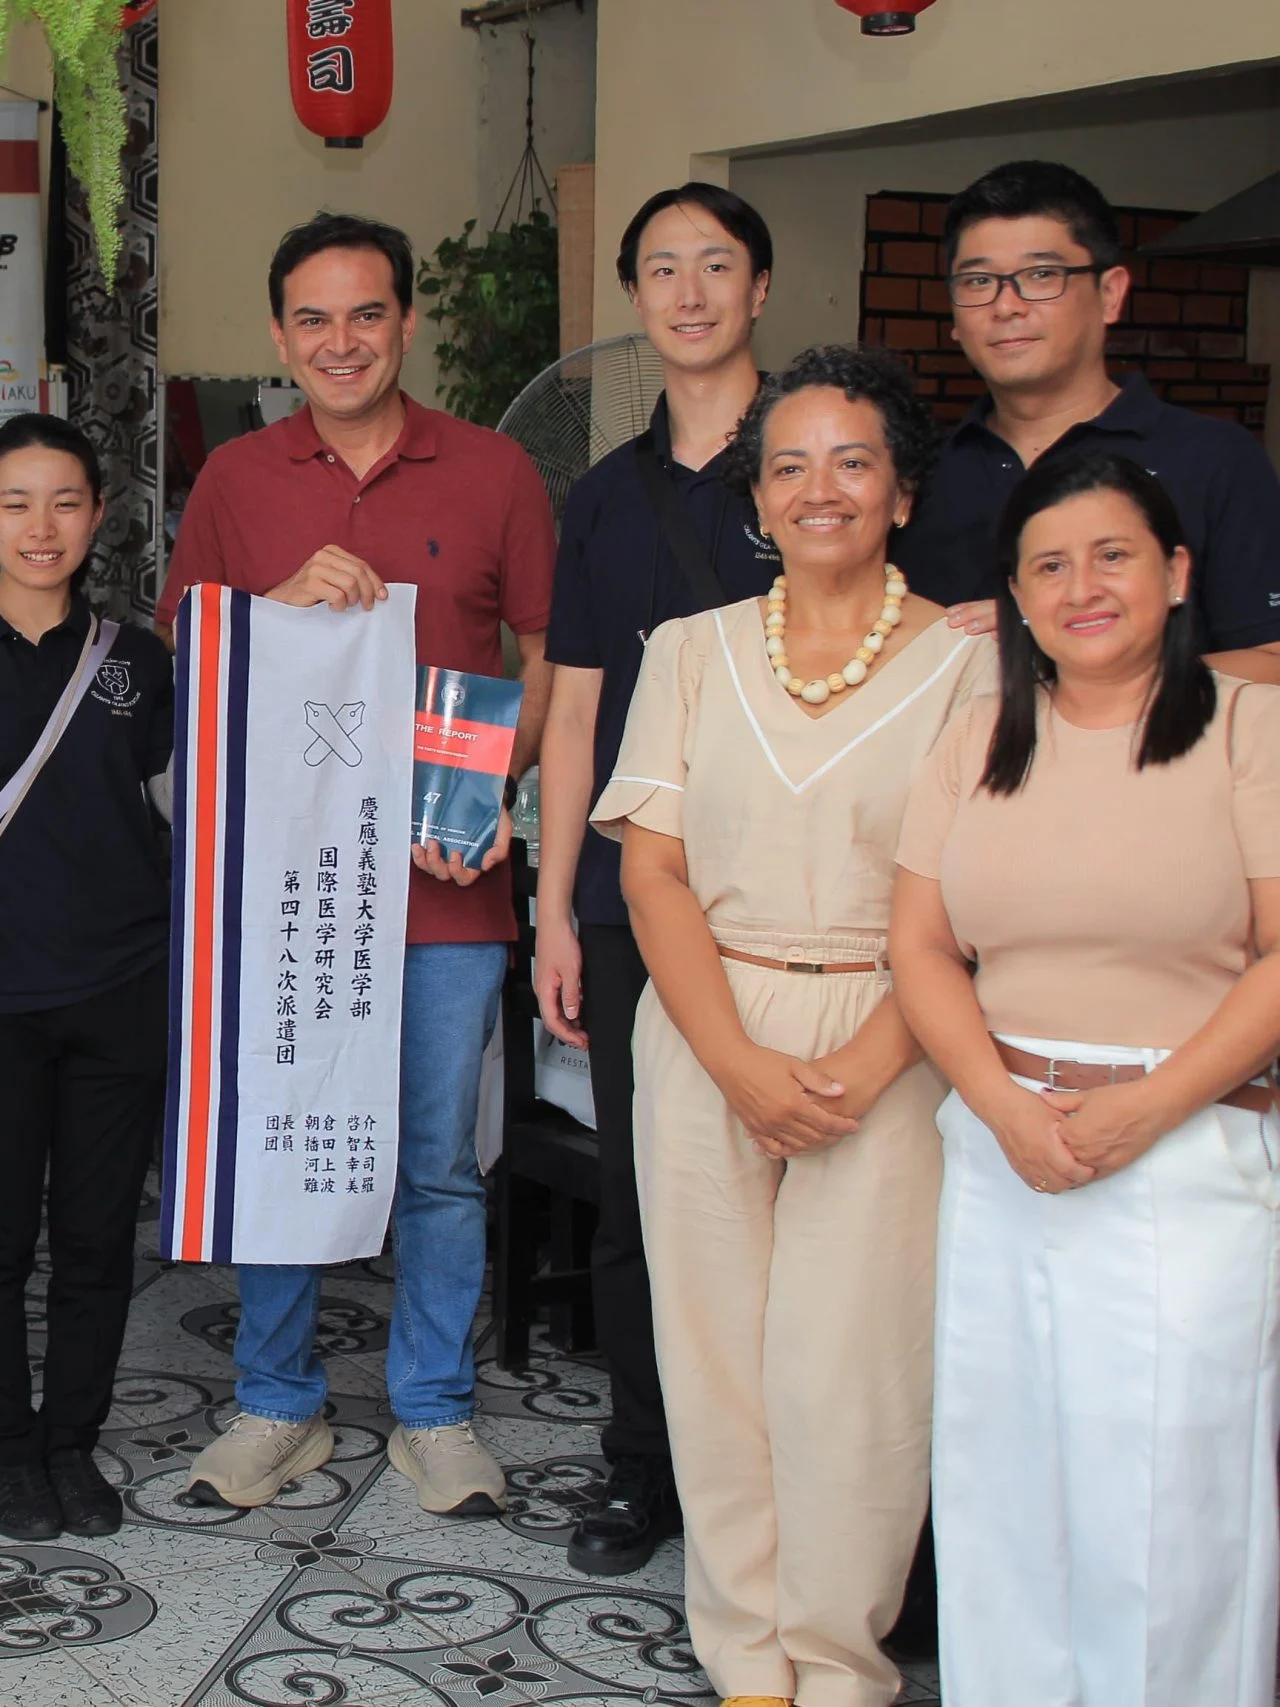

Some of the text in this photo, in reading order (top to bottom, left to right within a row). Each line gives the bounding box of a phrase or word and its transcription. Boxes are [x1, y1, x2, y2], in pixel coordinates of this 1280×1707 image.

[416, 723, 478, 742] THE REPORT
[423, 792, 442, 804] 47
[443, 836, 480, 847] ASSOCIATION
[349, 795, 379, 1021] 慶應義塾大学医学部
[314, 846, 338, 1020] 国際医学研究会
[276, 870, 300, 1065] 第四十八次派遣団
[561, 1056, 588, 1069] RESTA
[266, 1114, 377, 1131] 団長 朝倉 啓介
[265, 1134, 294, 1152] 団員
[346, 1135, 376, 1152] 智太
[304, 1156, 375, 1173] 河上 幸司
[304, 1177, 336, 1194] 難波
